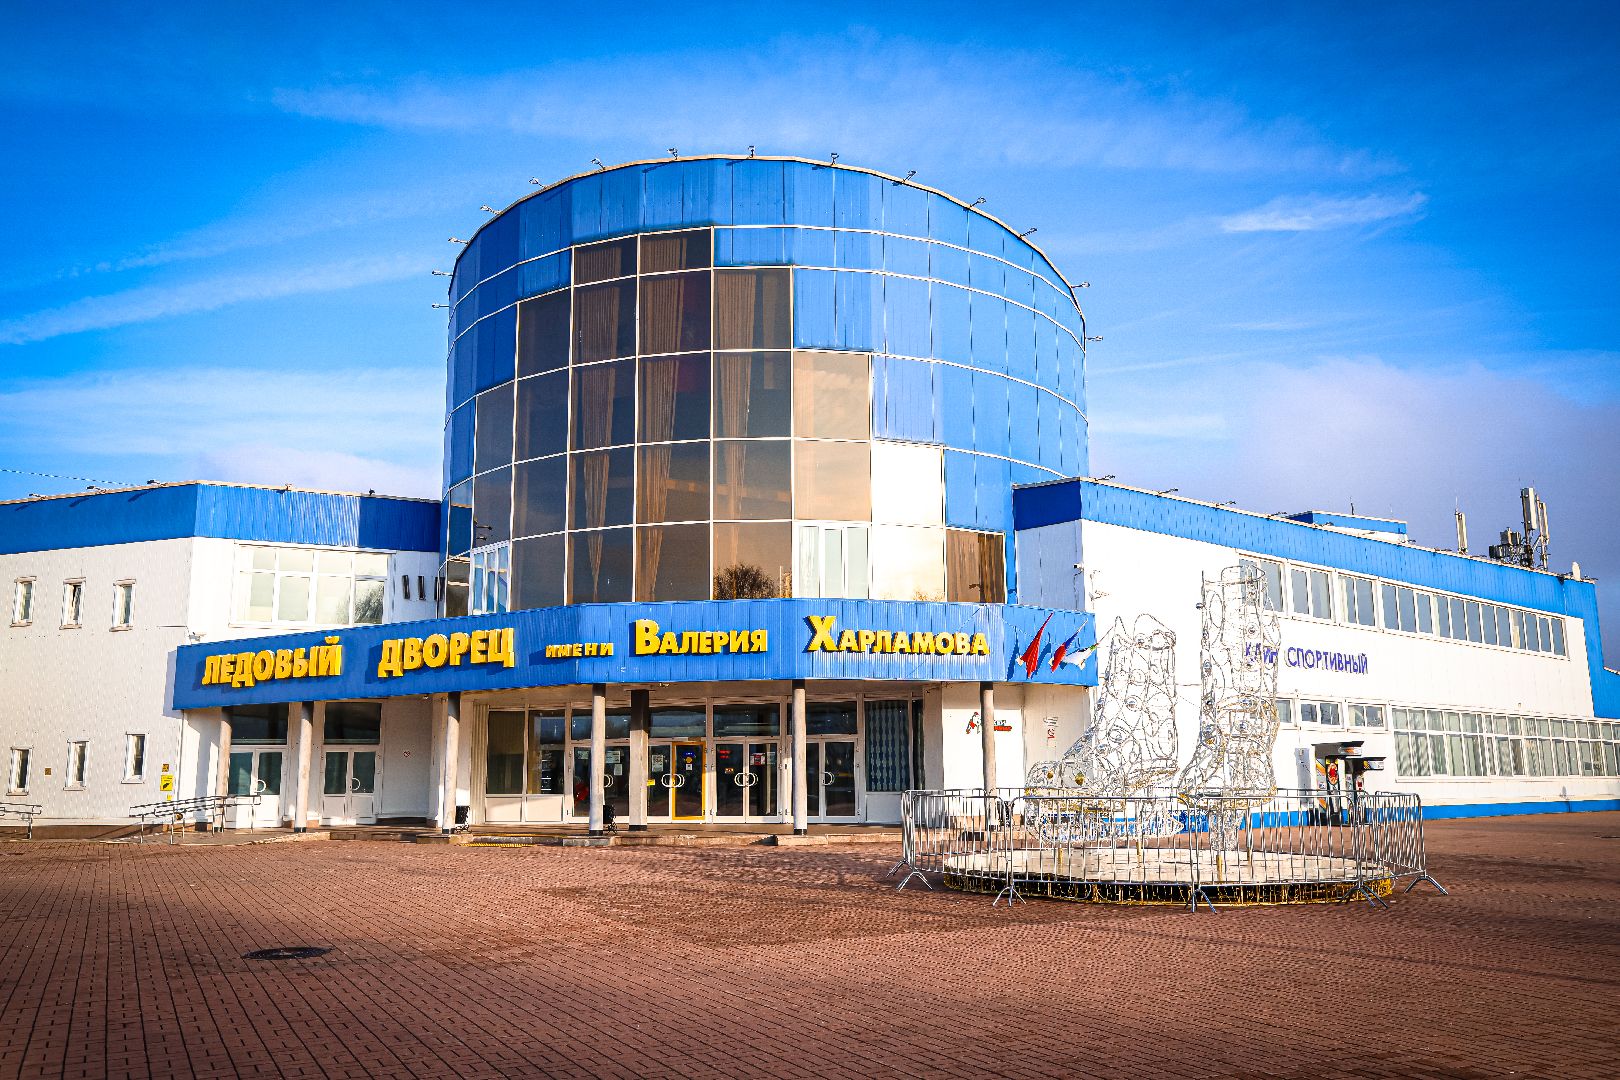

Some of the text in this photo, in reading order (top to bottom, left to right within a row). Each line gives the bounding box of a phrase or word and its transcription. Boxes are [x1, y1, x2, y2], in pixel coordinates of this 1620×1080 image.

[202, 614, 990, 688] ЛЕДОВЫЙ ДВОРЕЦ ИМЕНИ ВАЛЕРИЯ ХАРЛАМОВА
[1287, 647, 1368, 674] СПОРТИВНЫЙ
